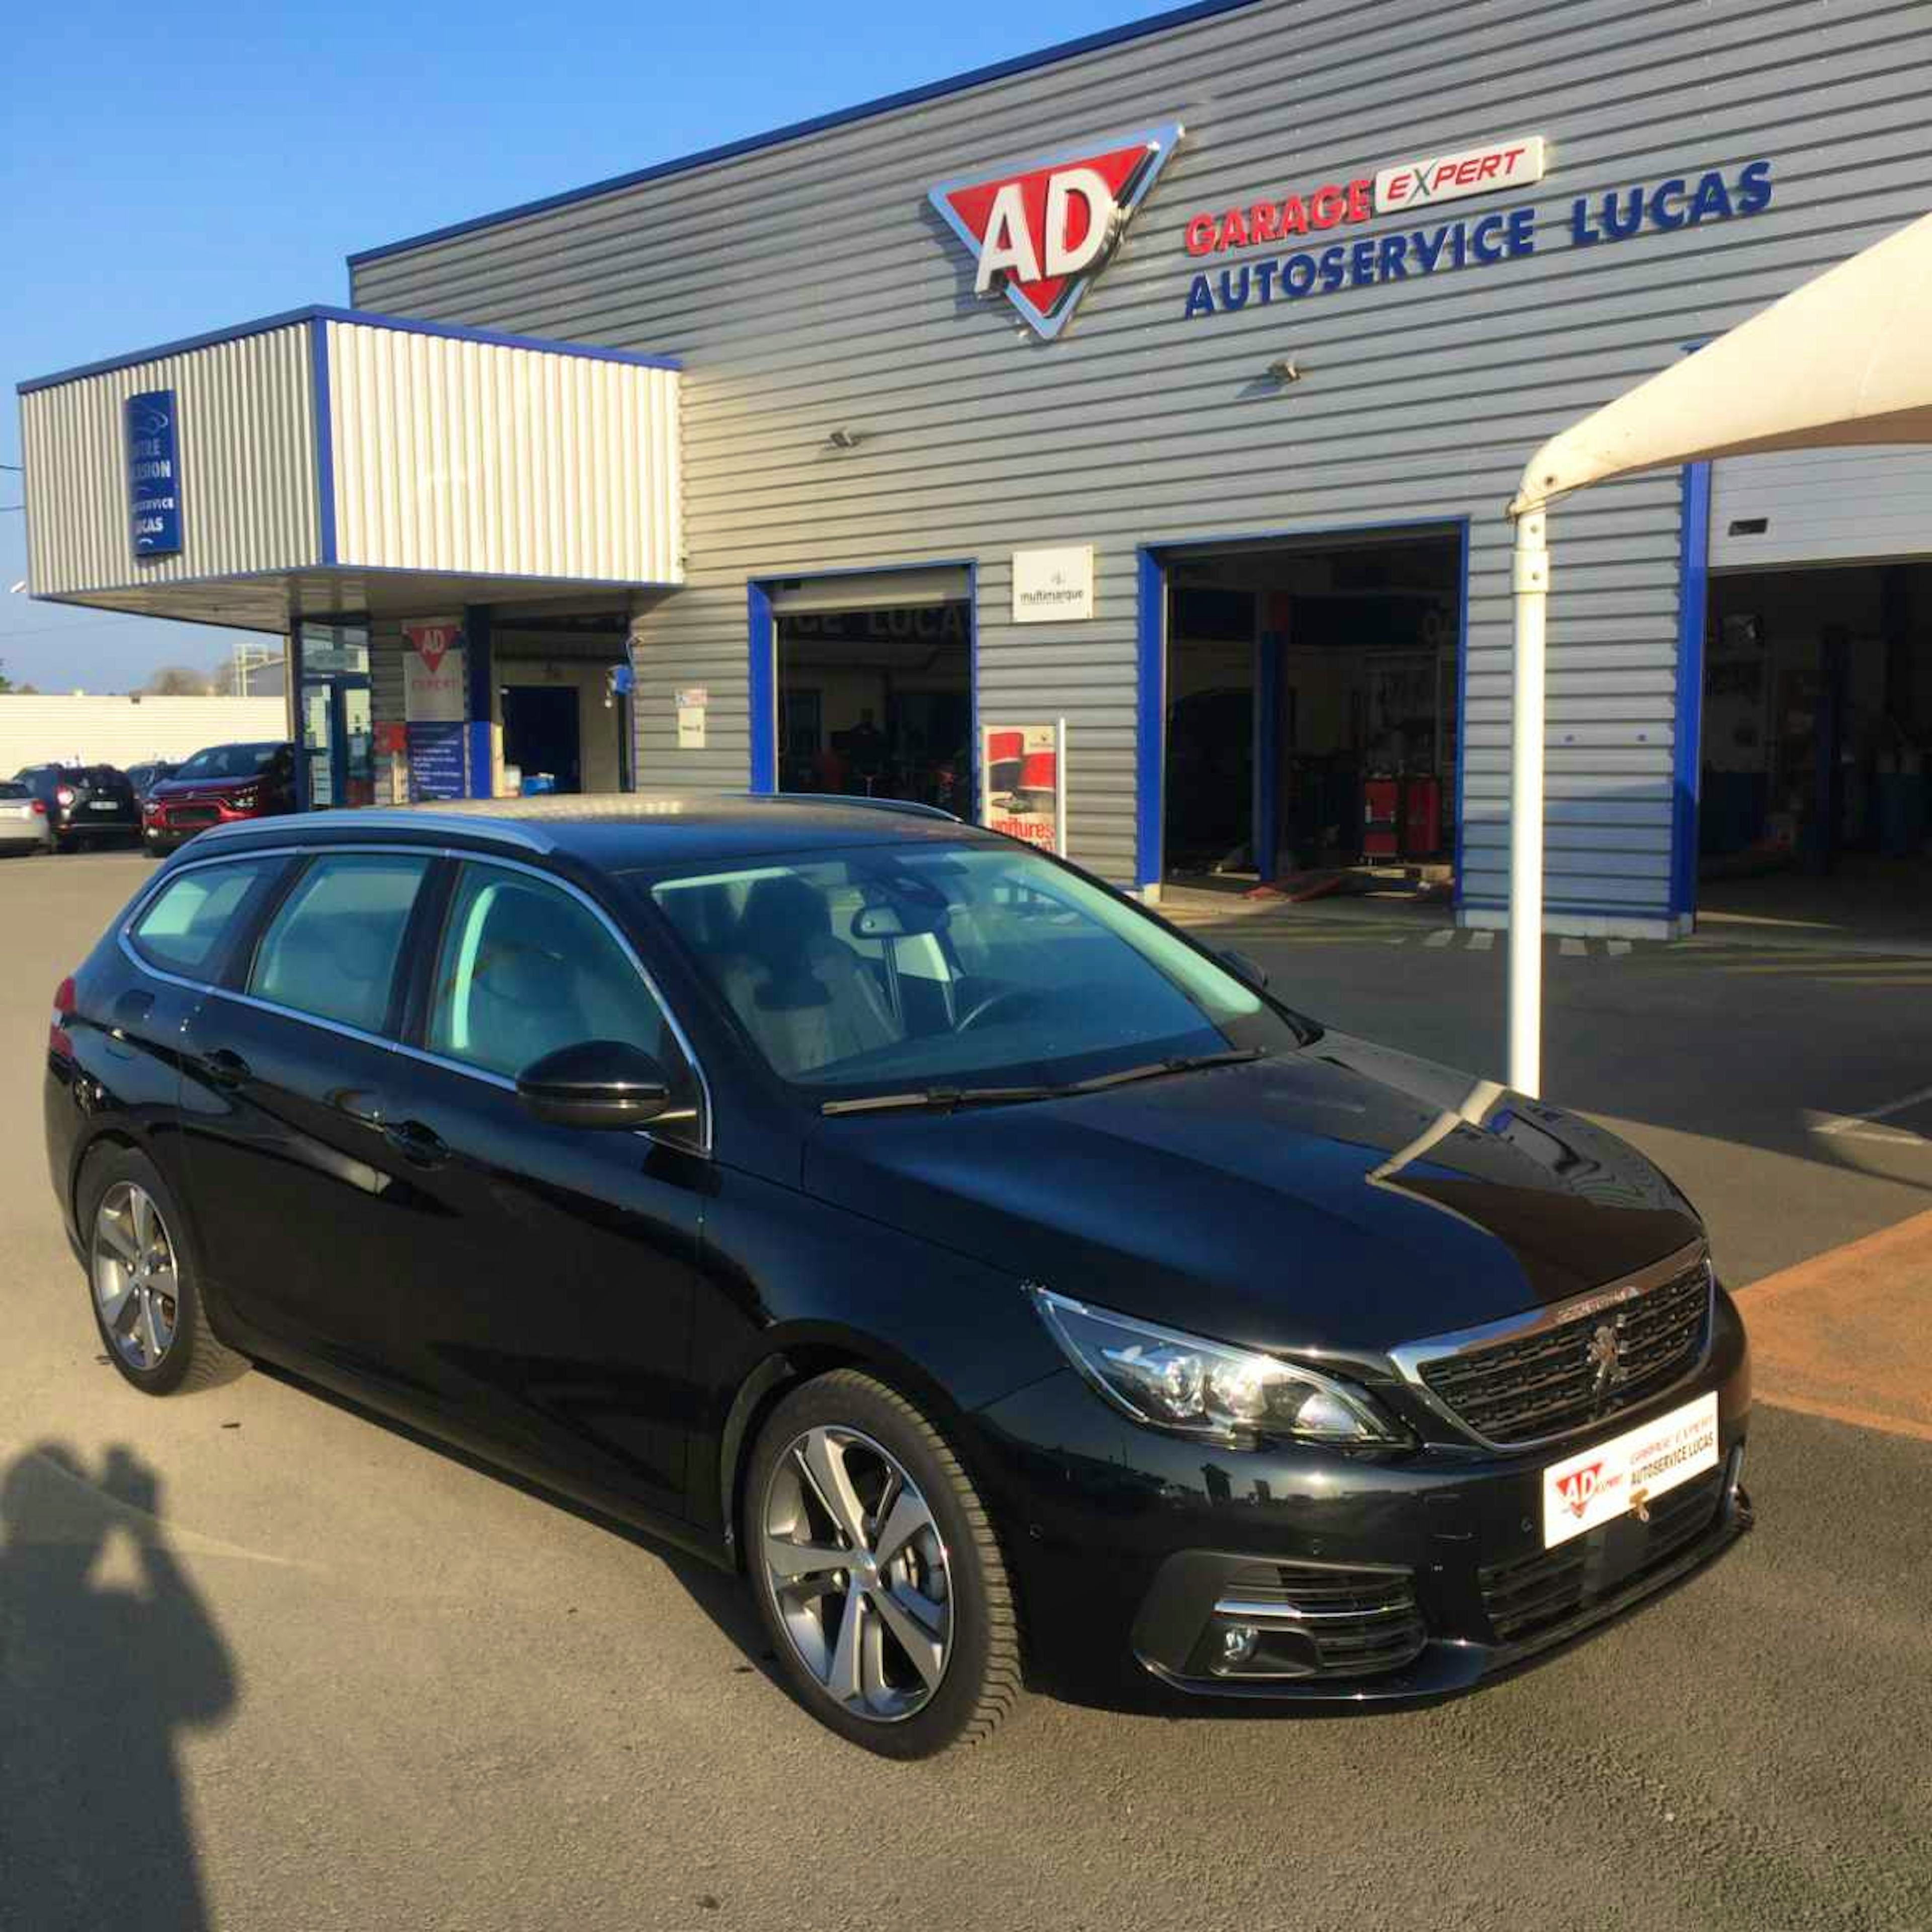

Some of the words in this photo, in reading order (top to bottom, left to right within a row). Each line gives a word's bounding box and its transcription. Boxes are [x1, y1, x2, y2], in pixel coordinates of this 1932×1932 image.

[1184, 180, 1373, 257] GARAGE
[1387, 149, 1525, 202] EXPERT
[974, 168, 1115, 294] AD
[1184, 208, 1536, 321] AUTOSERVICE
[1572, 160, 1772, 247] LUCAS
[422, 629, 445, 653] AD
[867, 607, 964, 642] LUCA
[1632, 1445, 1687, 1485] AUTOSERVICE
[1688, 1431, 1714, 1457] LUCAS
[1567, 1472, 1597, 1503] AD
